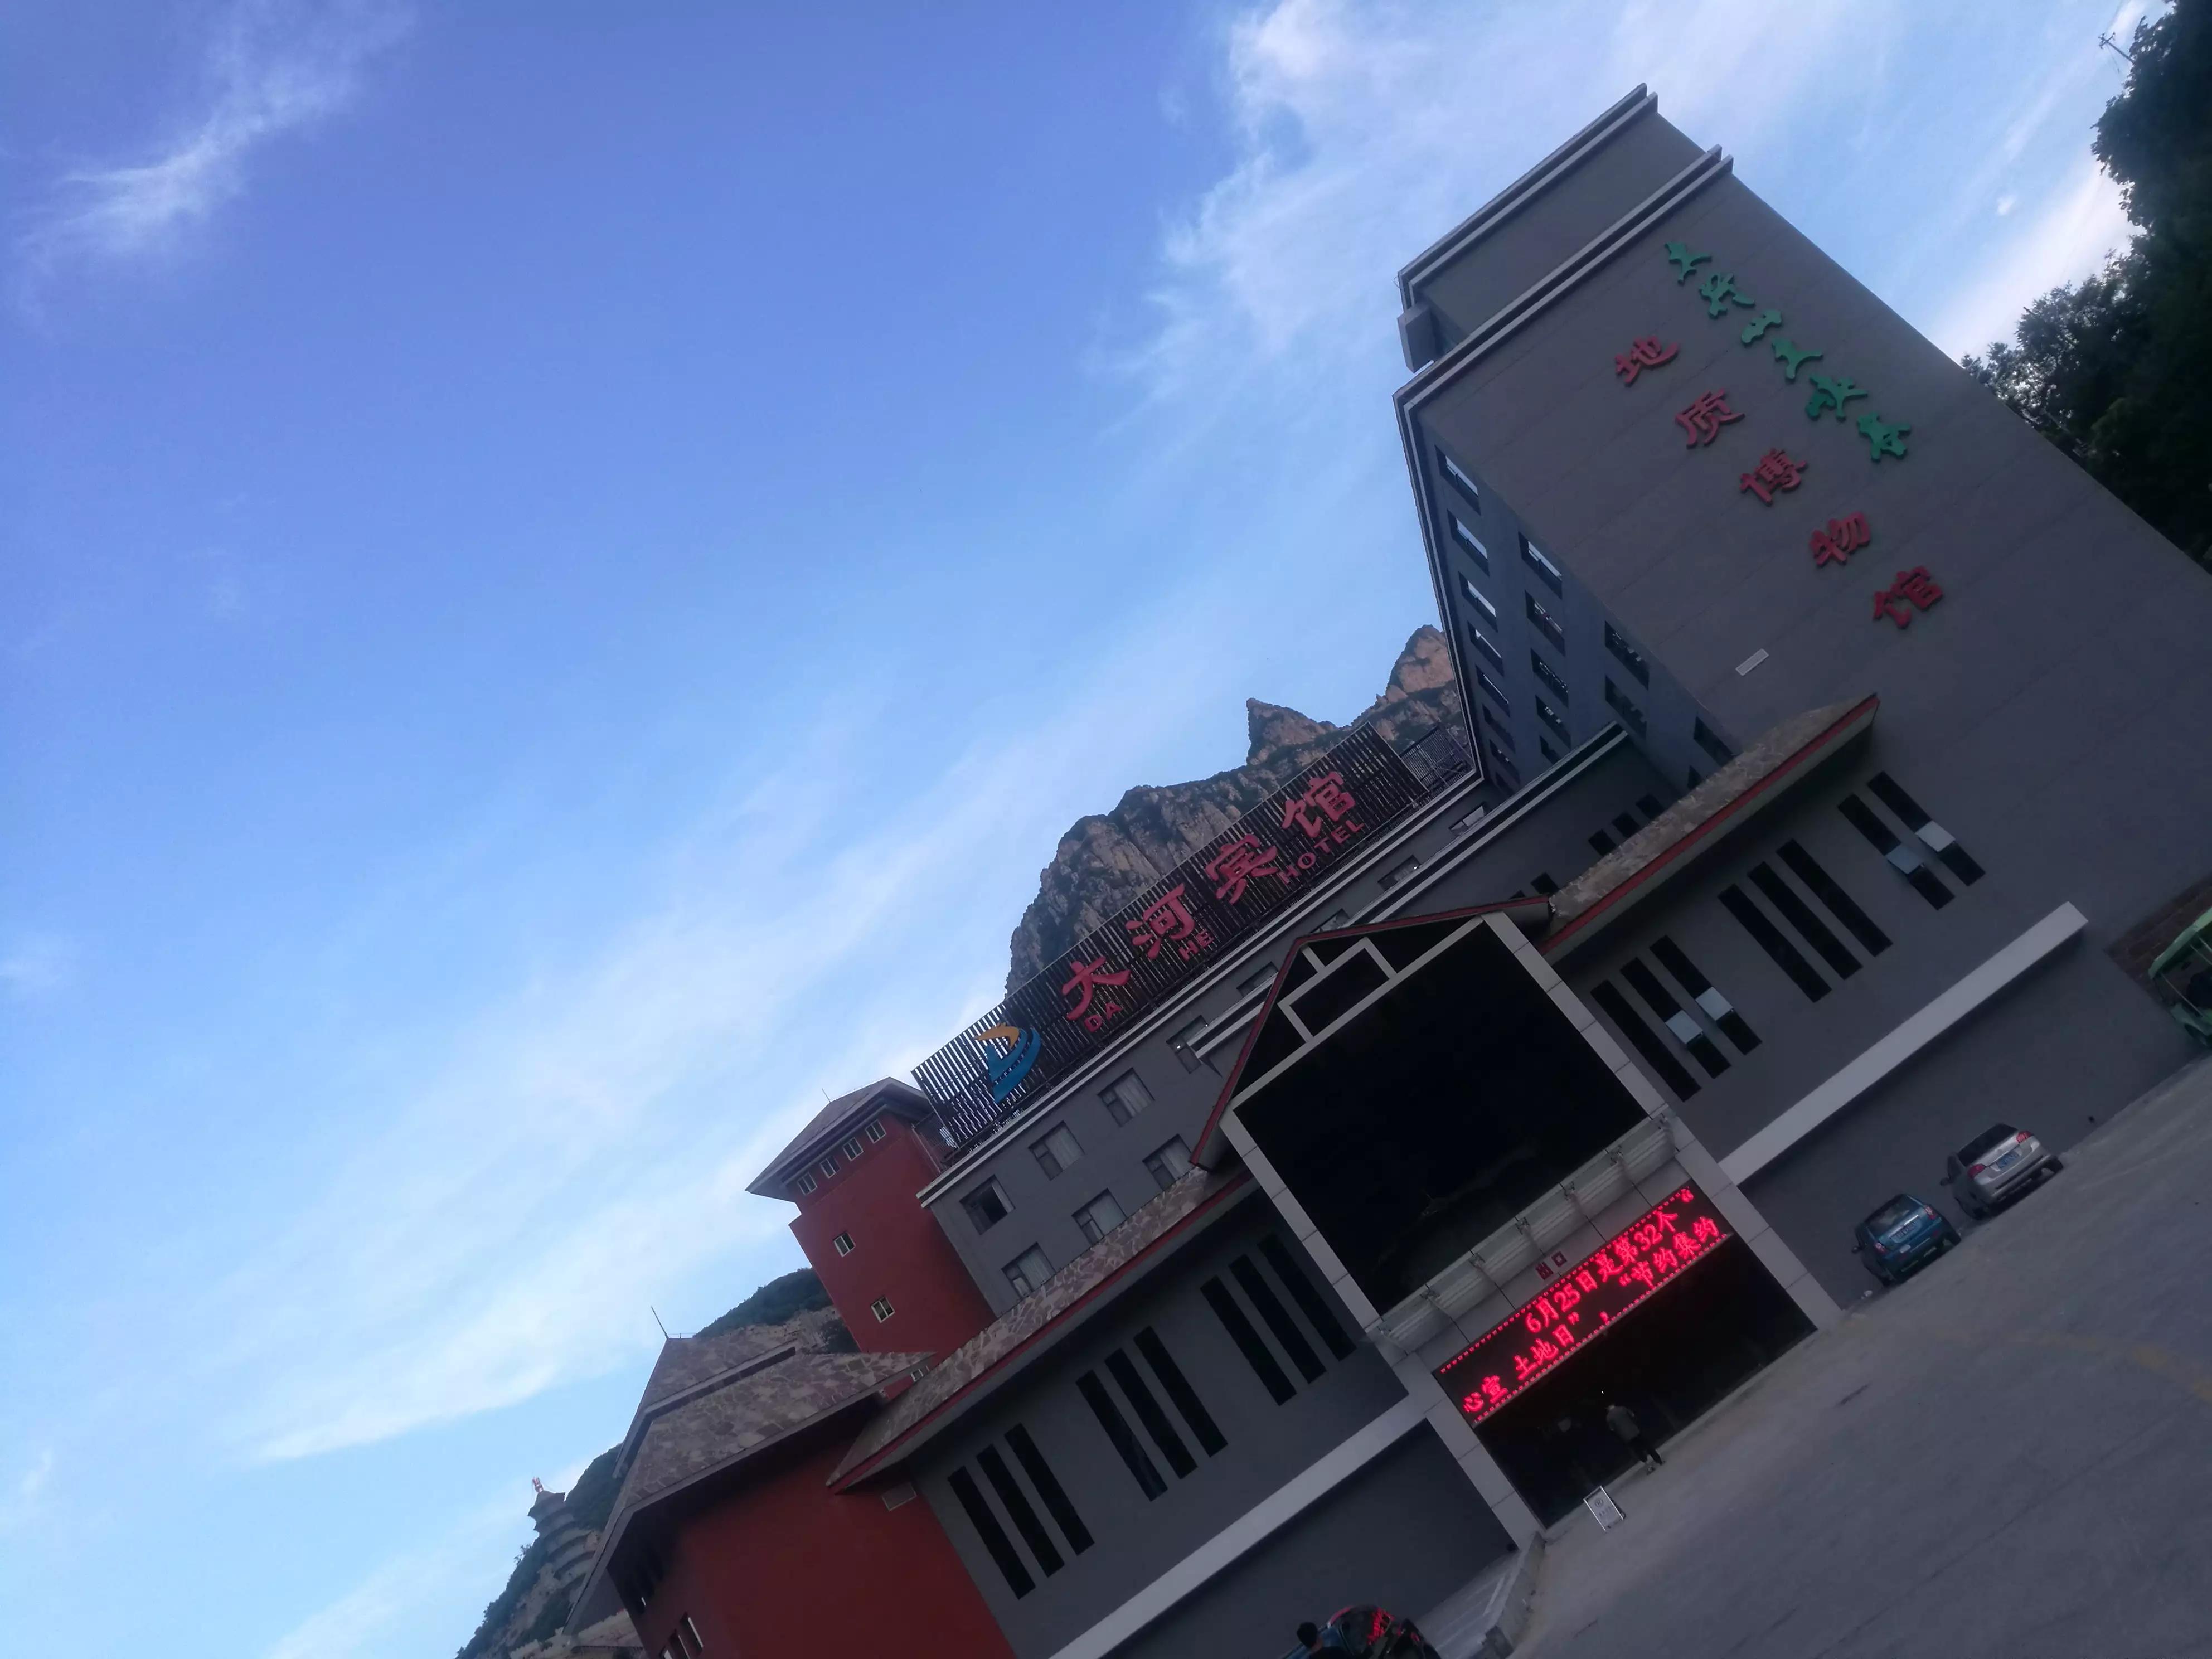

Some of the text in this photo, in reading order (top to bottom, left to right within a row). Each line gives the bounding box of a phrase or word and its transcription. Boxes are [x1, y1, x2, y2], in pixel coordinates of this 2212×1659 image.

[1614, 336, 1943, 629] 地质博物馆
[1061, 770, 1356, 1021] 大河宾馆
[1084, 819, 1365, 1032] DA HE HOTEL
[1535, 1251, 1567, 1280] 出口
